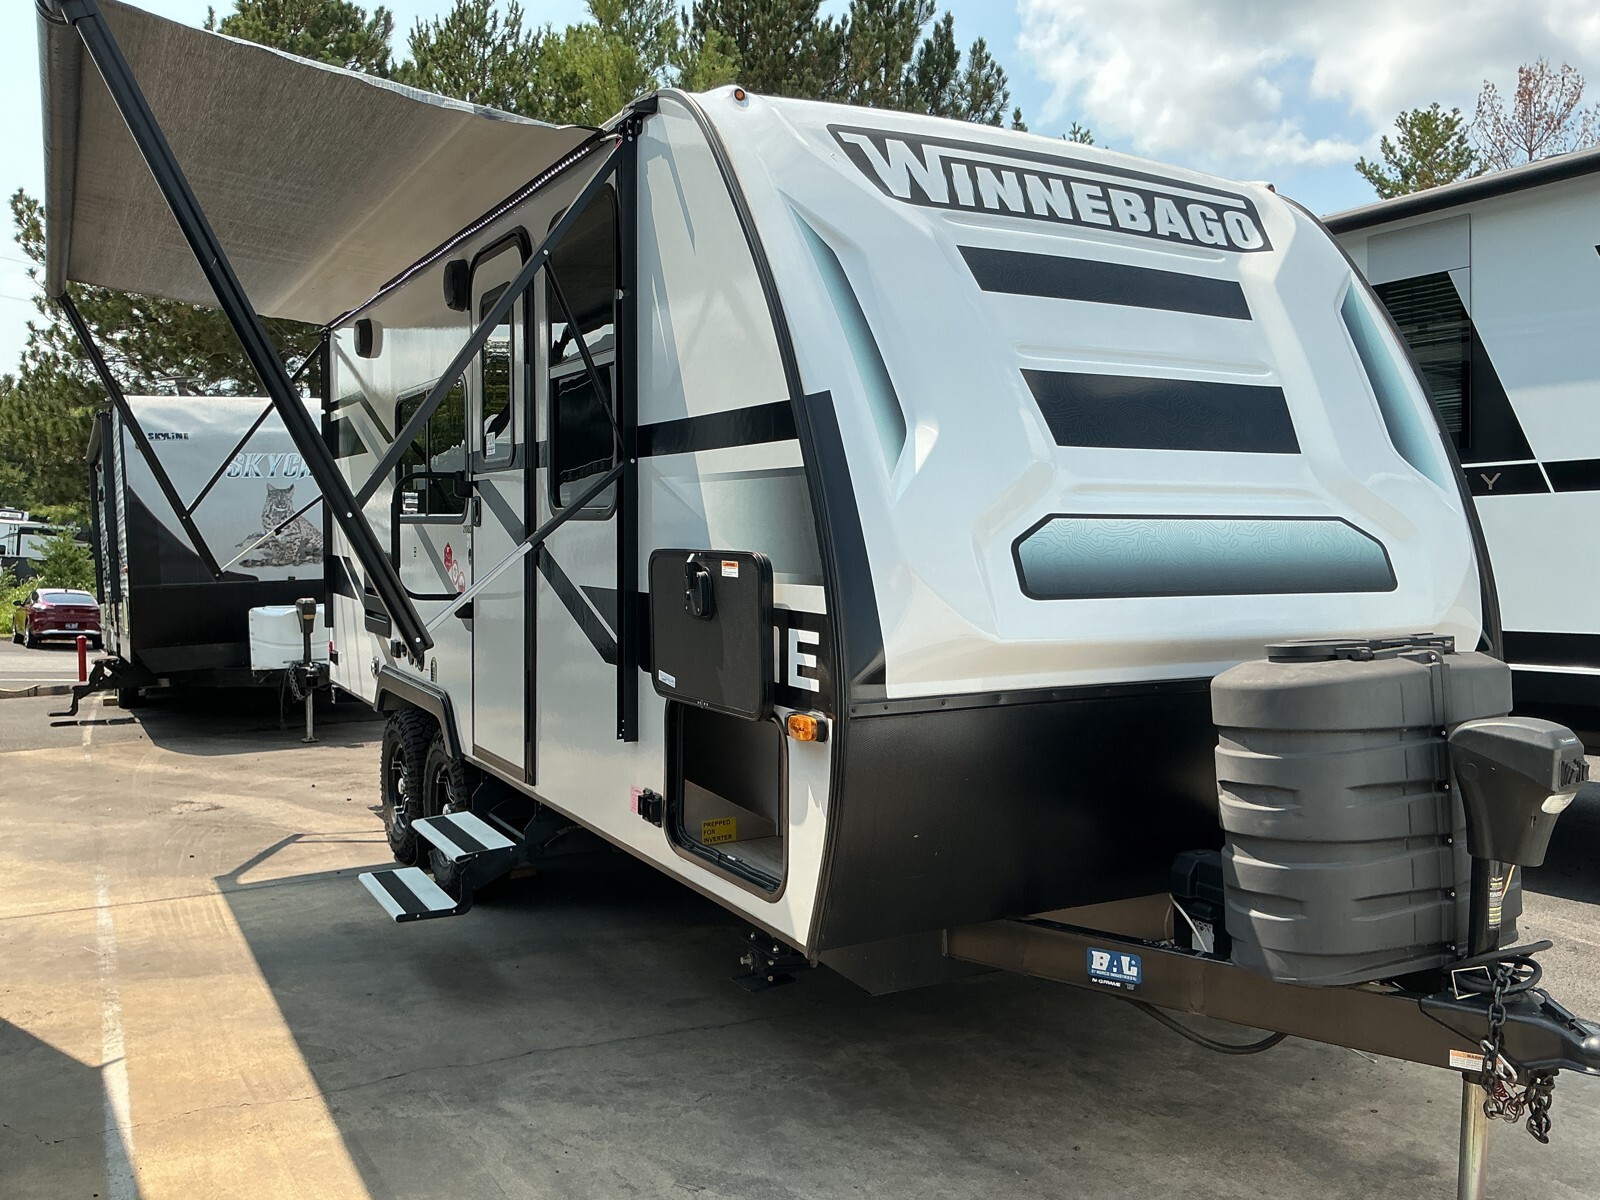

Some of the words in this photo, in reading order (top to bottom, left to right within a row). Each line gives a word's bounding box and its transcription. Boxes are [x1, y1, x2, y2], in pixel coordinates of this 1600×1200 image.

[838, 132, 1264, 250] WINNEBAGO
[703, 819, 731, 828] PREPPED
[703, 834, 733, 843] INVERTER
